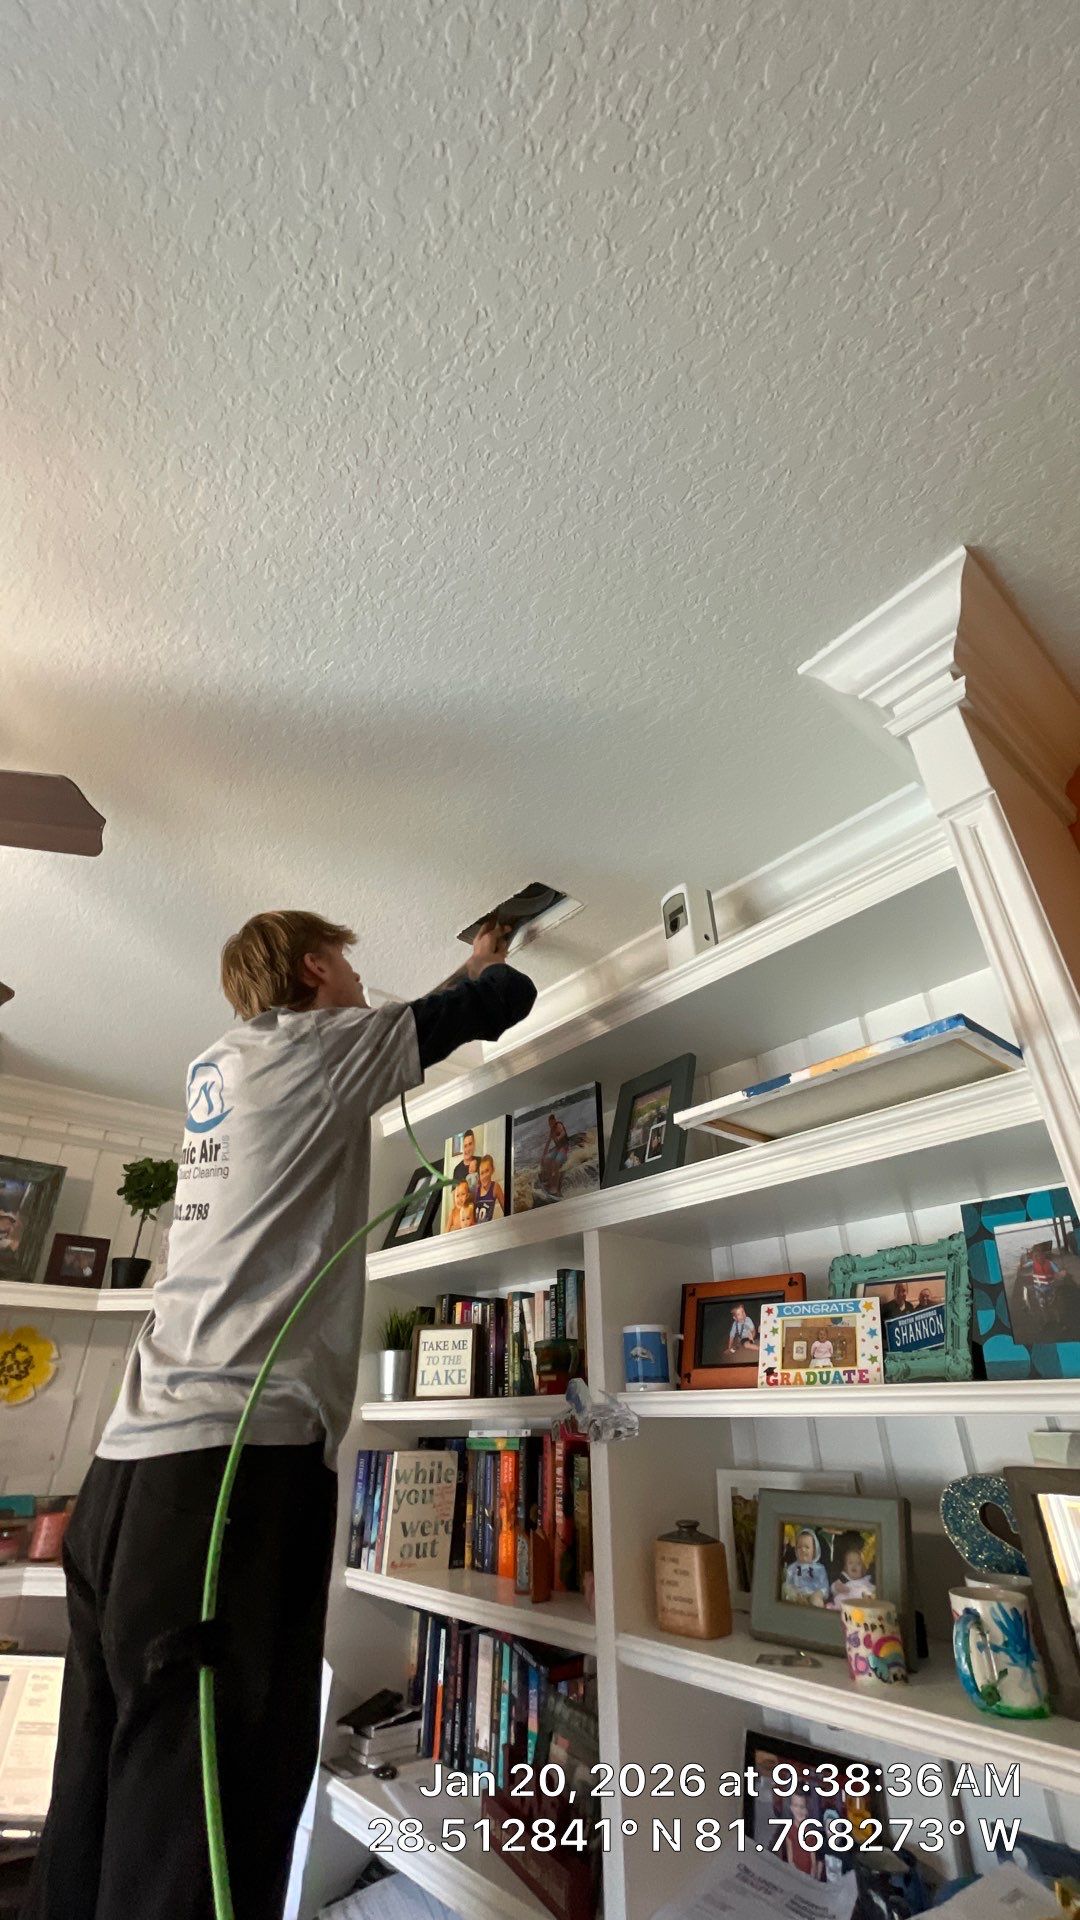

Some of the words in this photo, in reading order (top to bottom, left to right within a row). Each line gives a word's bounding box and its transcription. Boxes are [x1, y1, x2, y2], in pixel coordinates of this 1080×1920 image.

[199, 1137, 222, 1163] Air
[221, 1135, 230, 1162] PLUS
[193, 1166, 230, 1180] Cleaning
[782, 1302, 855, 1315] CONGRATS
[894, 1314, 945, 1347] SHANNON
[421, 1340, 450, 1351] TAKE
[451, 1339, 469, 1350] ME
[426, 1355, 440, 1366] TO
[442, 1354, 462, 1366] THE
[419, 1368, 468, 1386] LAKE
[765, 1368, 871, 1388] GRADUATE
[555, 1441, 564, 1462] THE
[395, 1461, 455, 1484] while
[392, 1487, 435, 1514] you
[399, 1539, 440, 1559] out
